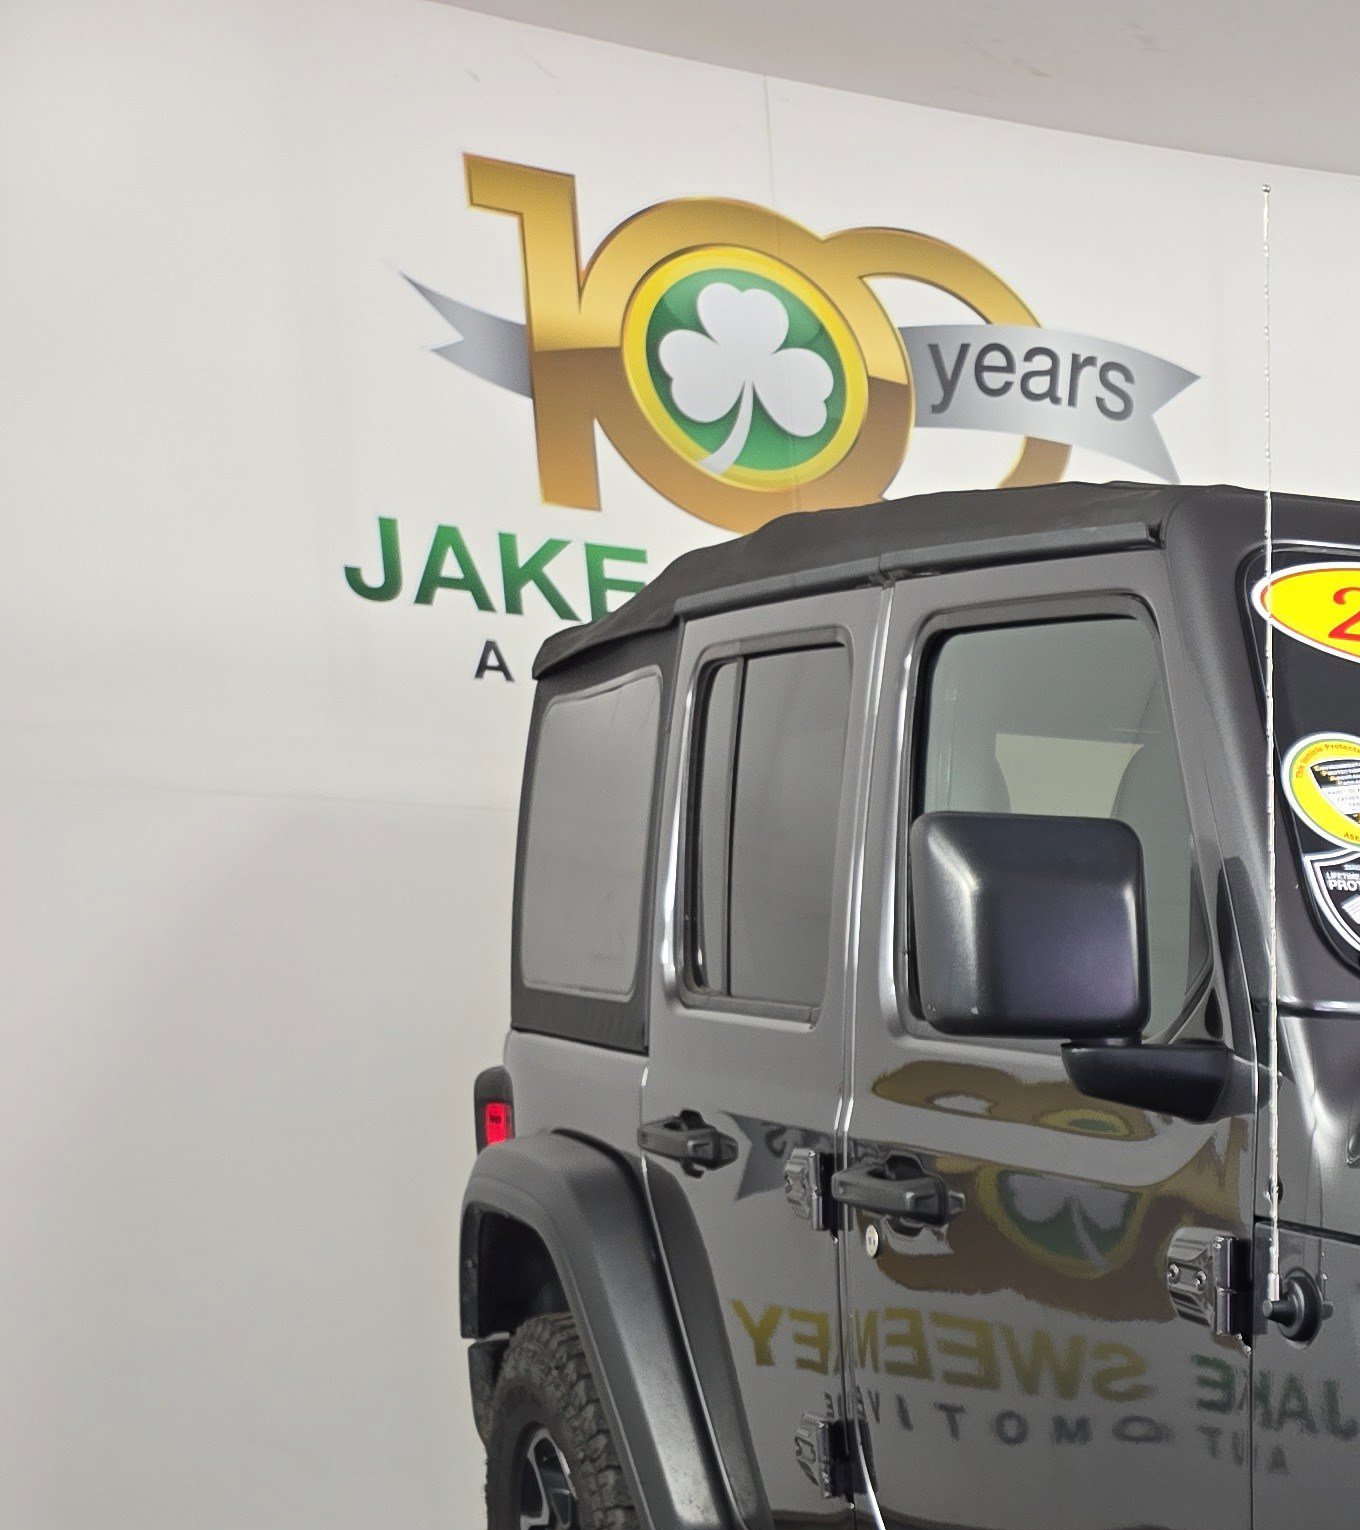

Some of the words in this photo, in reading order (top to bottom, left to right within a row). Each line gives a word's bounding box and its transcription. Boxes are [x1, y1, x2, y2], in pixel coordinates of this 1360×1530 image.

[928, 340, 1137, 421] years
[343, 515, 649, 624] JAKE
[1343, 831, 1360, 842] ASK
